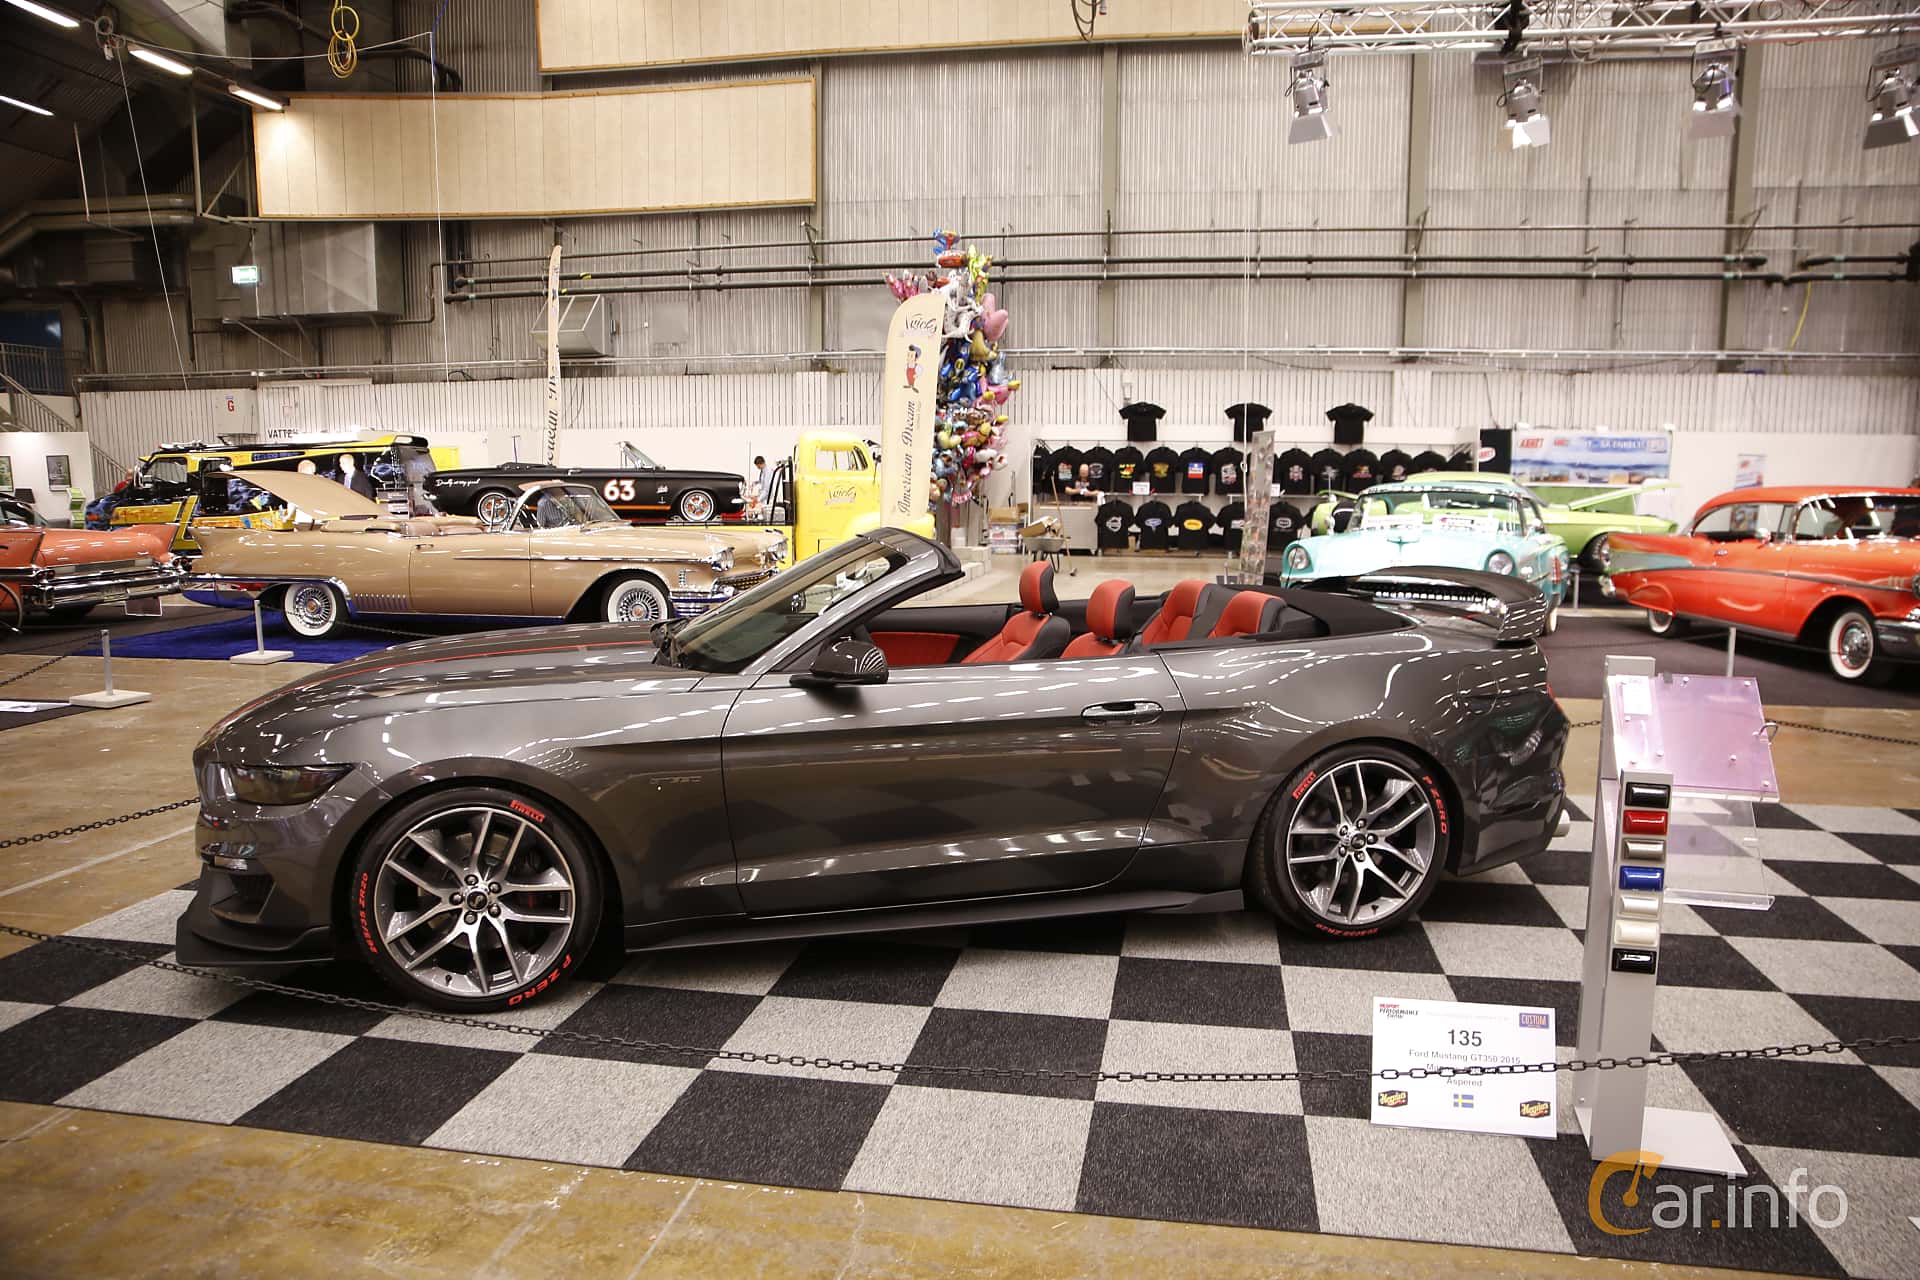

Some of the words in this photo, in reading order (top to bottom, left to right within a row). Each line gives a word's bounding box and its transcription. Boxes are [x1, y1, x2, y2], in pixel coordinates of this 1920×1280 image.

[227, 400, 235, 412] G
[901, 400, 915, 447] Dream
[604, 479, 636, 501] 63
[897, 453, 912, 516] American
[508, 968, 560, 1006] ZERO
[1448, 1029, 1482, 1047] 135
[1409, 1048, 1429, 1057] Ford
[1431, 1051, 1468, 1062] Mustang
[1470, 1053, 1498, 1063] GT350
[1500, 1055, 1521, 1065] 2015
